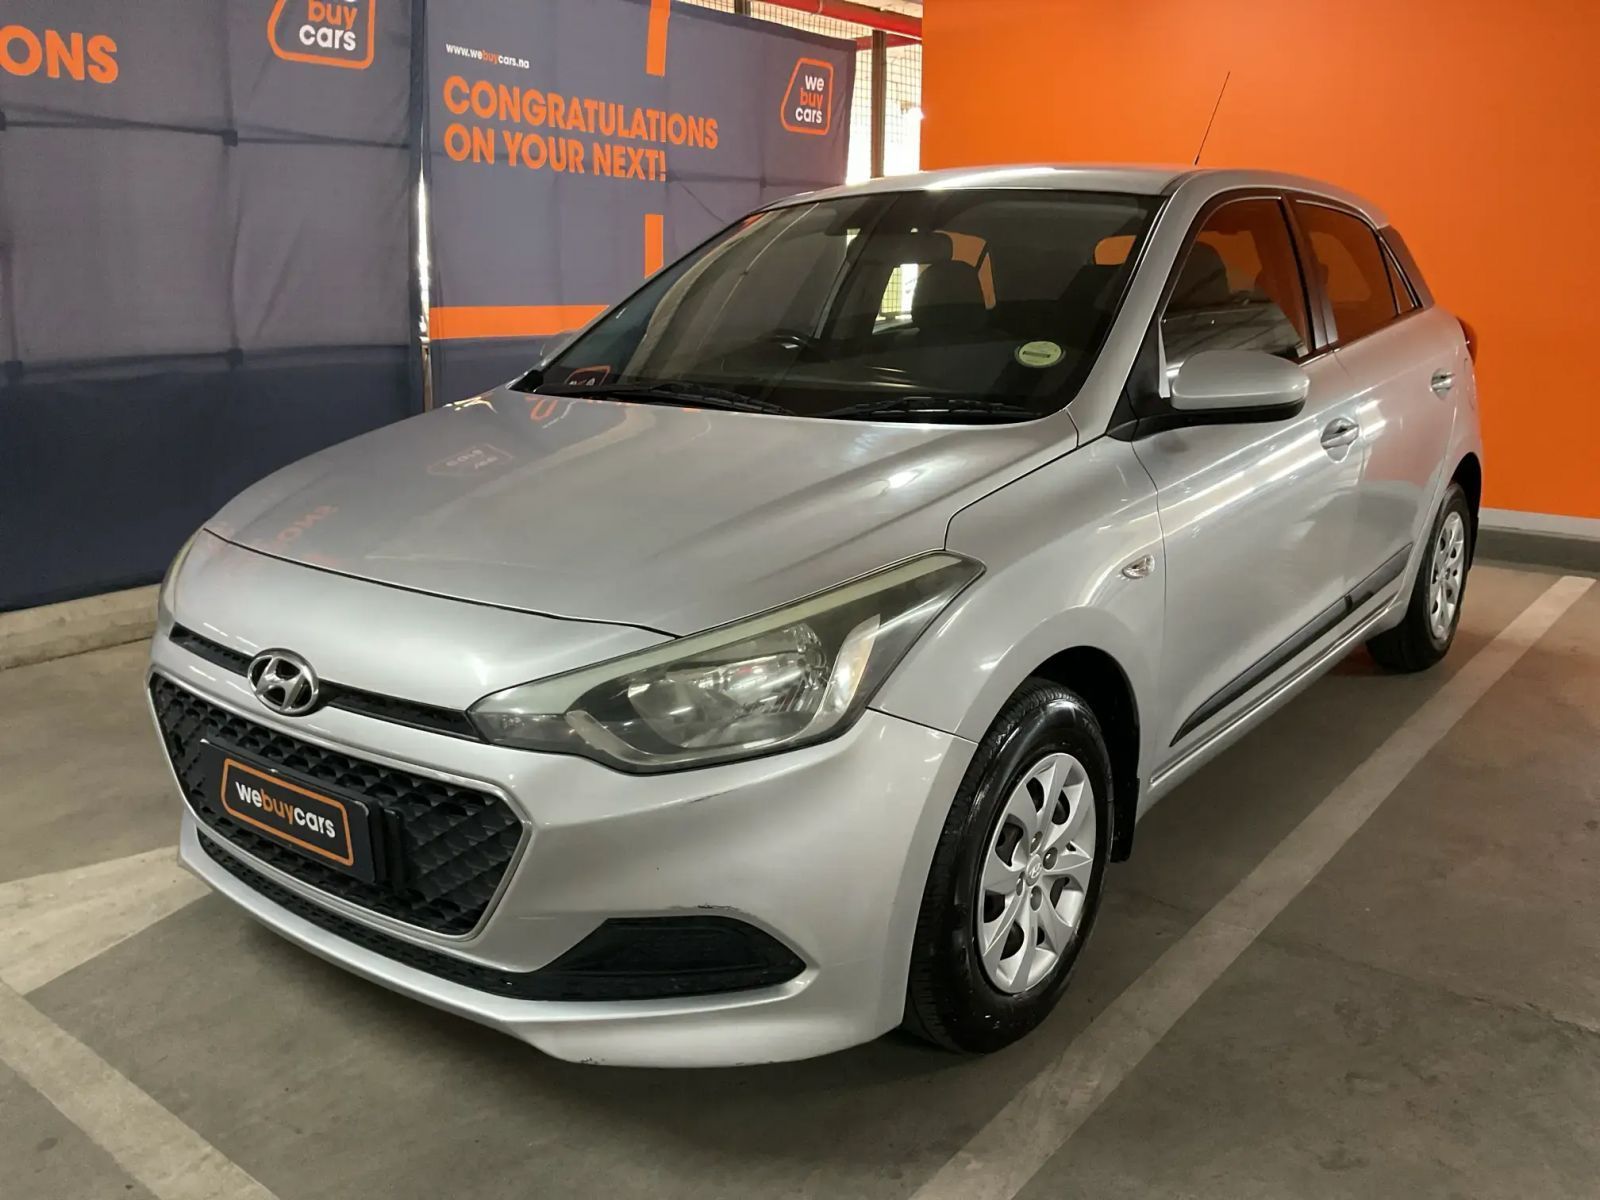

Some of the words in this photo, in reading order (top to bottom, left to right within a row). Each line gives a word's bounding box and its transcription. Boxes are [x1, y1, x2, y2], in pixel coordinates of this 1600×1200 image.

[308, 0, 358, 31] buy
[299, 24, 356, 51] cars
[0, 25, 119, 84] ONS
[445, 43, 530, 69] www.webuycars.na
[805, 75, 825, 91] we
[443, 75, 719, 149] CONGRATULATIONS
[800, 88, 823, 110] buy
[795, 107, 823, 124] cars
[444, 122, 495, 164] ON
[503, 130, 585, 174] YOUR
[592, 142, 667, 182] NEXT!
[235, 781, 336, 839] webuycars
